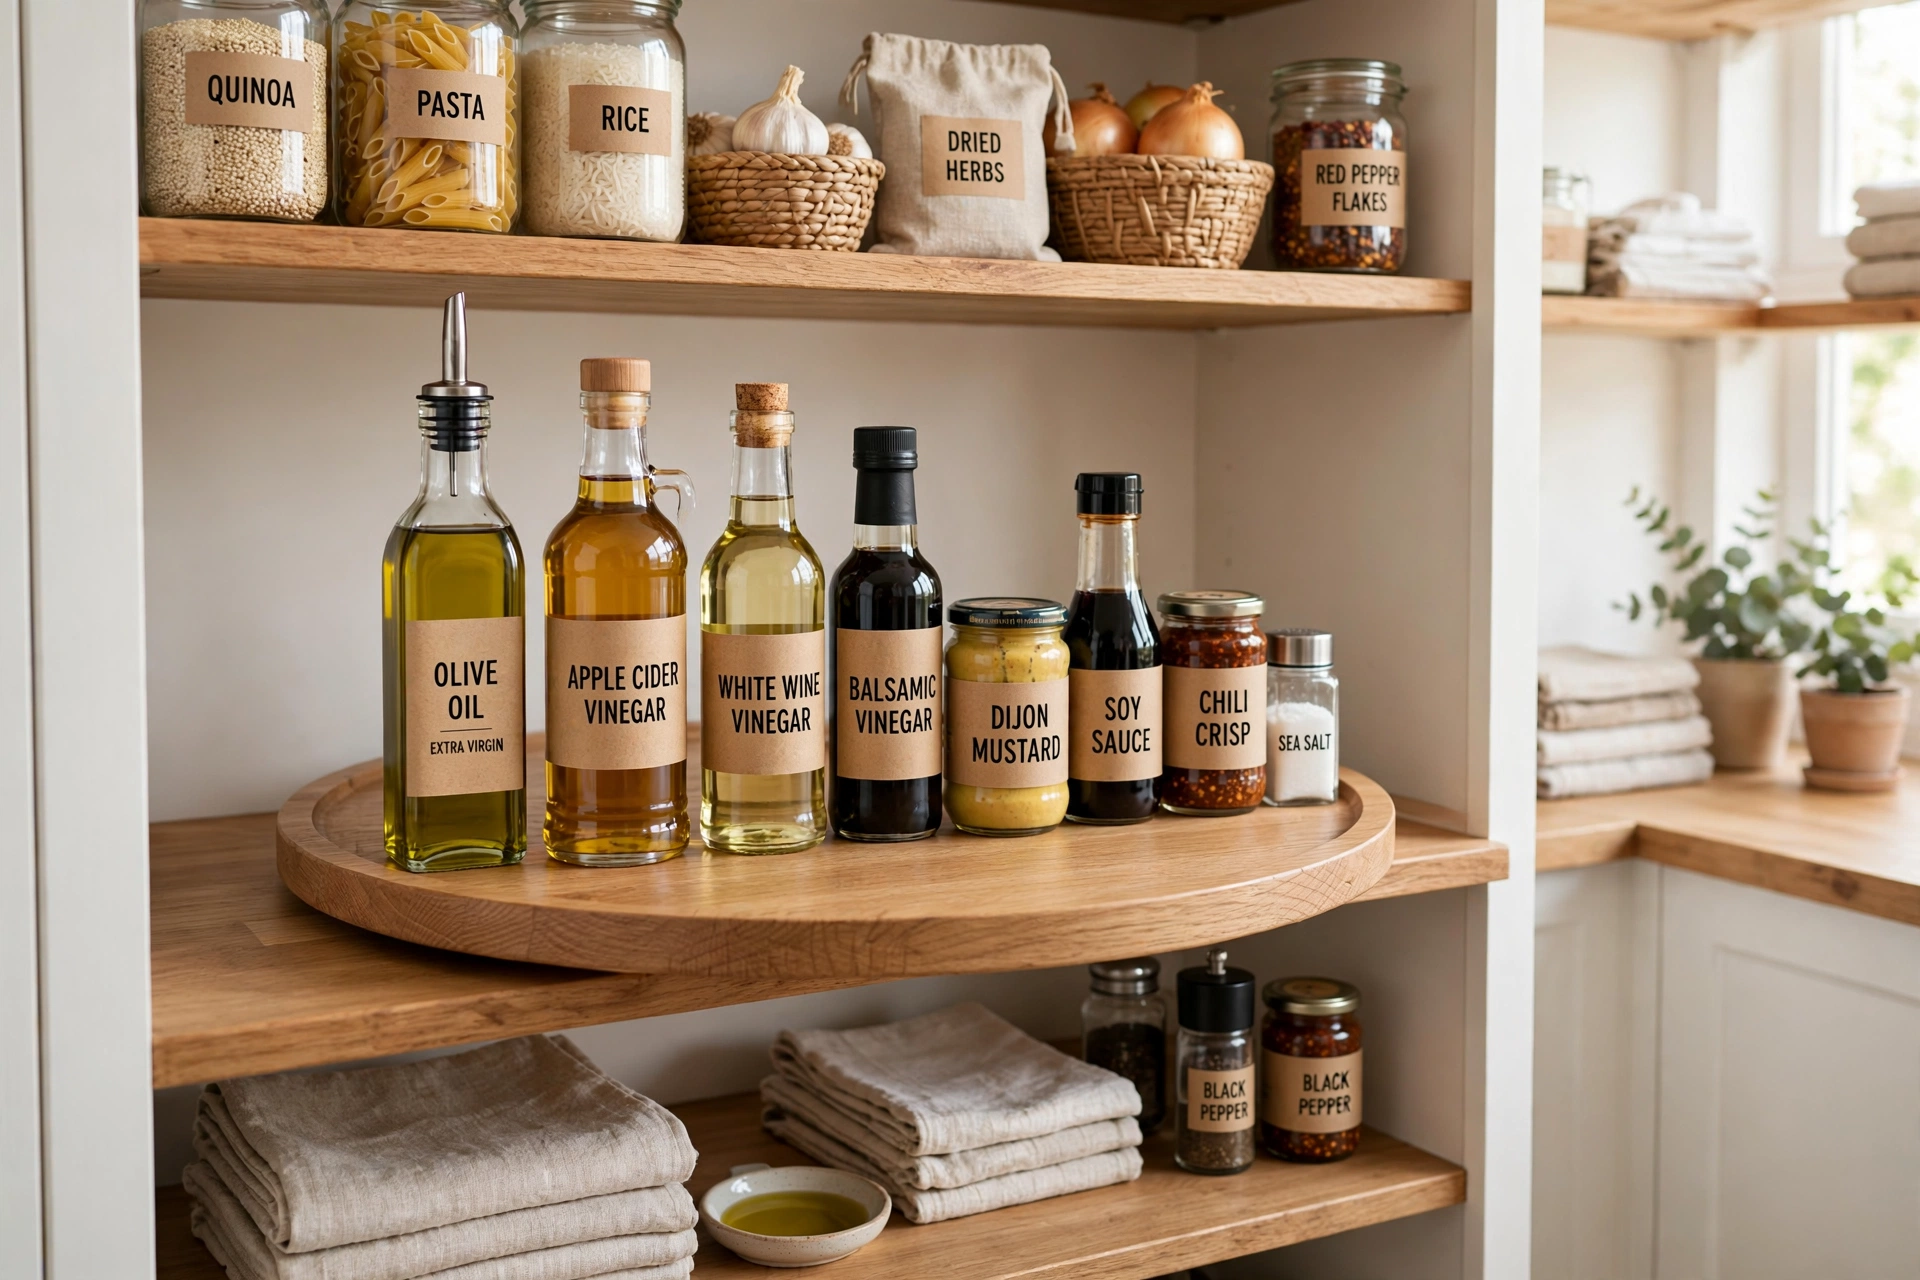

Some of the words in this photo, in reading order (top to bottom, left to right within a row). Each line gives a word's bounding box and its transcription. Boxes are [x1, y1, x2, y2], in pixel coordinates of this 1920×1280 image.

[207, 73, 296, 109] QUINOA
[417, 89, 485, 121] PASTA
[601, 104, 650, 133] RICE
[948, 130, 1001, 154] DRIED
[946, 159, 1005, 183] HERBS
[1315, 163, 1346, 185] RED
[1352, 164, 1400, 186] PEPPER
[1332, 191, 1387, 212] FLAKES
[434, 659, 498, 688] OLIVE
[567, 664, 626, 691] APPLE
[632, 661, 679, 690] CIDER
[717, 673, 777, 701] WHITE
[781, 671, 821, 700] WINE
[849, 674, 937, 702] BALSAMIC
[1198, 688, 1248, 715] CHILI
[448, 694, 485, 720] OIL
[583, 696, 666, 725] VINEGAR
[730, 706, 811, 735] VINEGAR
[991, 703, 1048, 730] DIJON
[1104, 695, 1141, 722] SOY
[854, 707, 933, 735] VINEGAR
[1195, 721, 1252, 747] CRISP
[430, 740, 465, 756] EXTRA
[467, 737, 504, 754] VIRGIN
[971, 734, 1062, 764] MUSTARD
[1091, 727, 1151, 755] SAUCE
[1277, 734, 1301, 752] SEA
[1303, 733, 1332, 752] SALT
[1203, 1079, 1246, 1099] BLACK
[1302, 1071, 1350, 1092] BLACK
[1200, 1101, 1248, 1121] PEPPER
[1298, 1095, 1351, 1116] PEPPER
